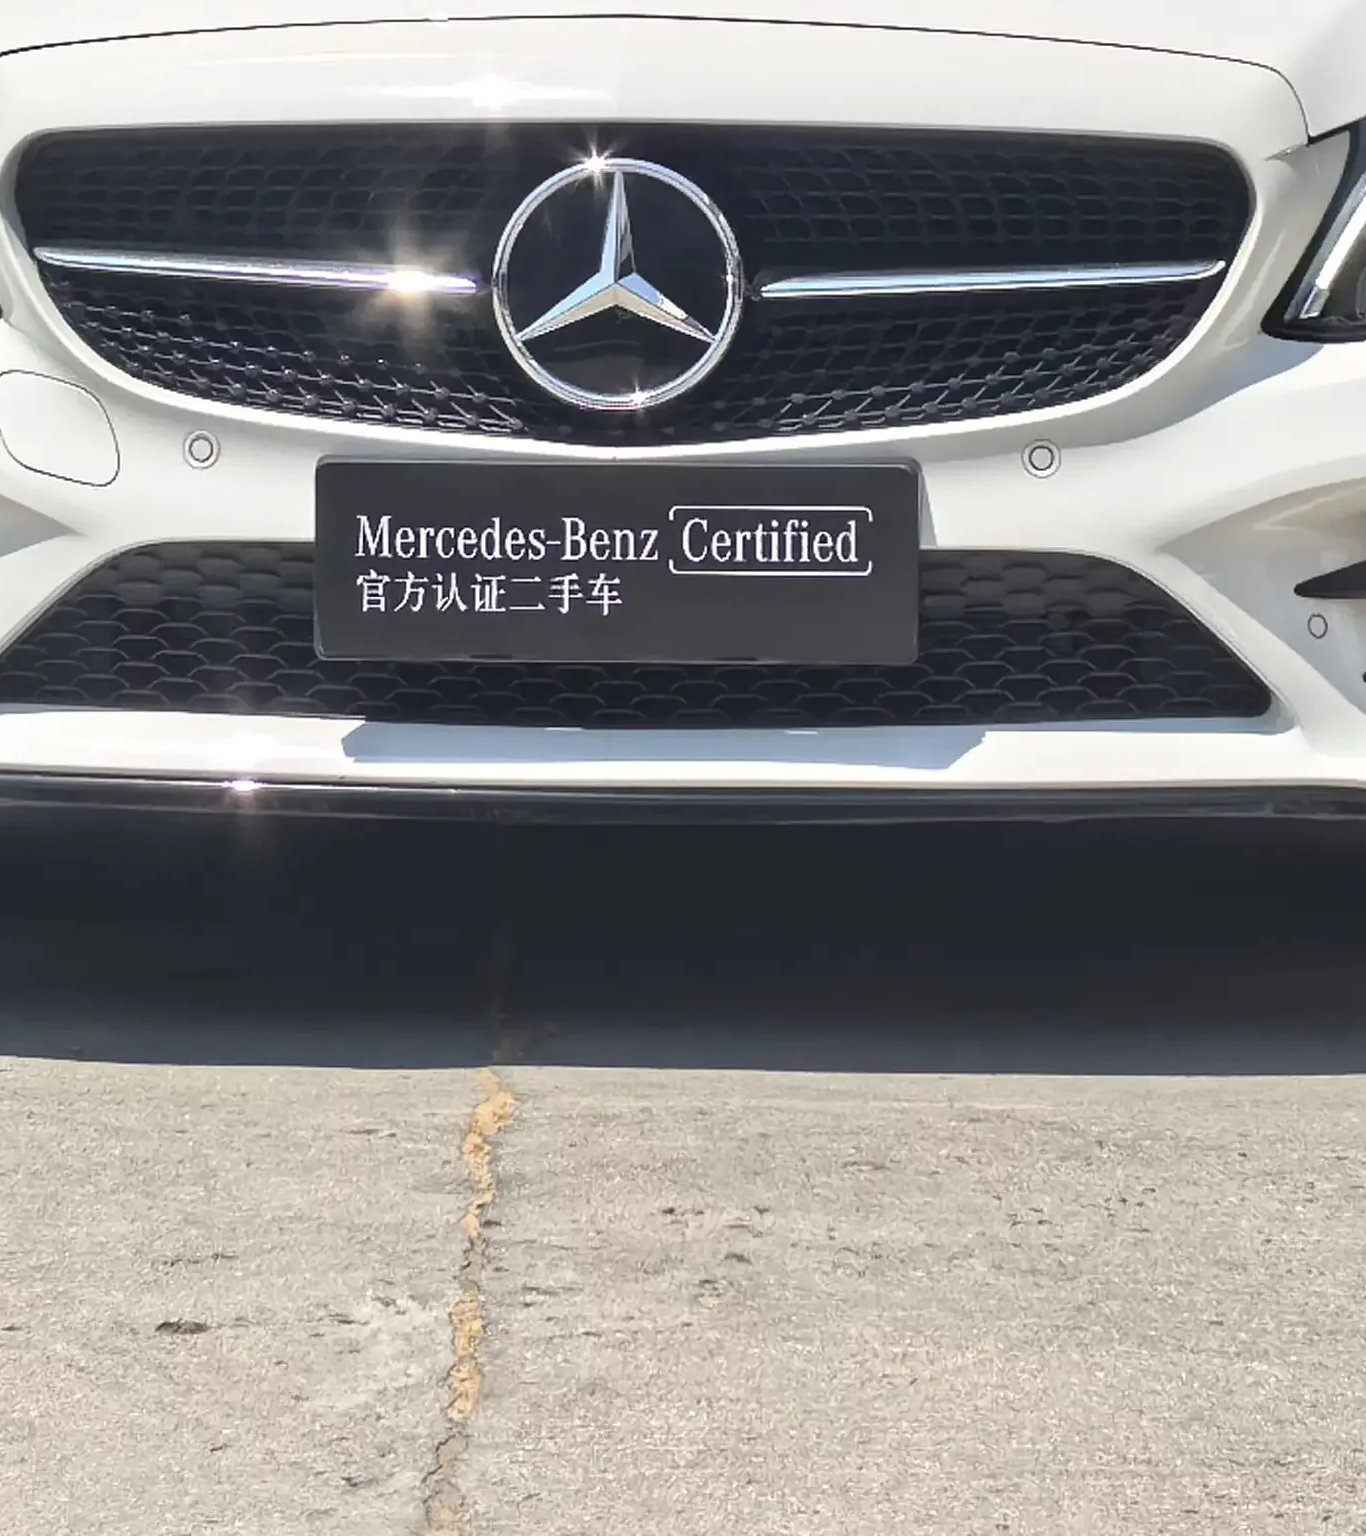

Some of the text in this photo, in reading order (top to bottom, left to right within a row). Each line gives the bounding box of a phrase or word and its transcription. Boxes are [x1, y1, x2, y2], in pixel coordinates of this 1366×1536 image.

[355, 514, 859, 563] Mercedes-Benz Certified
[356, 569, 624, 617] 官方认证二手车
